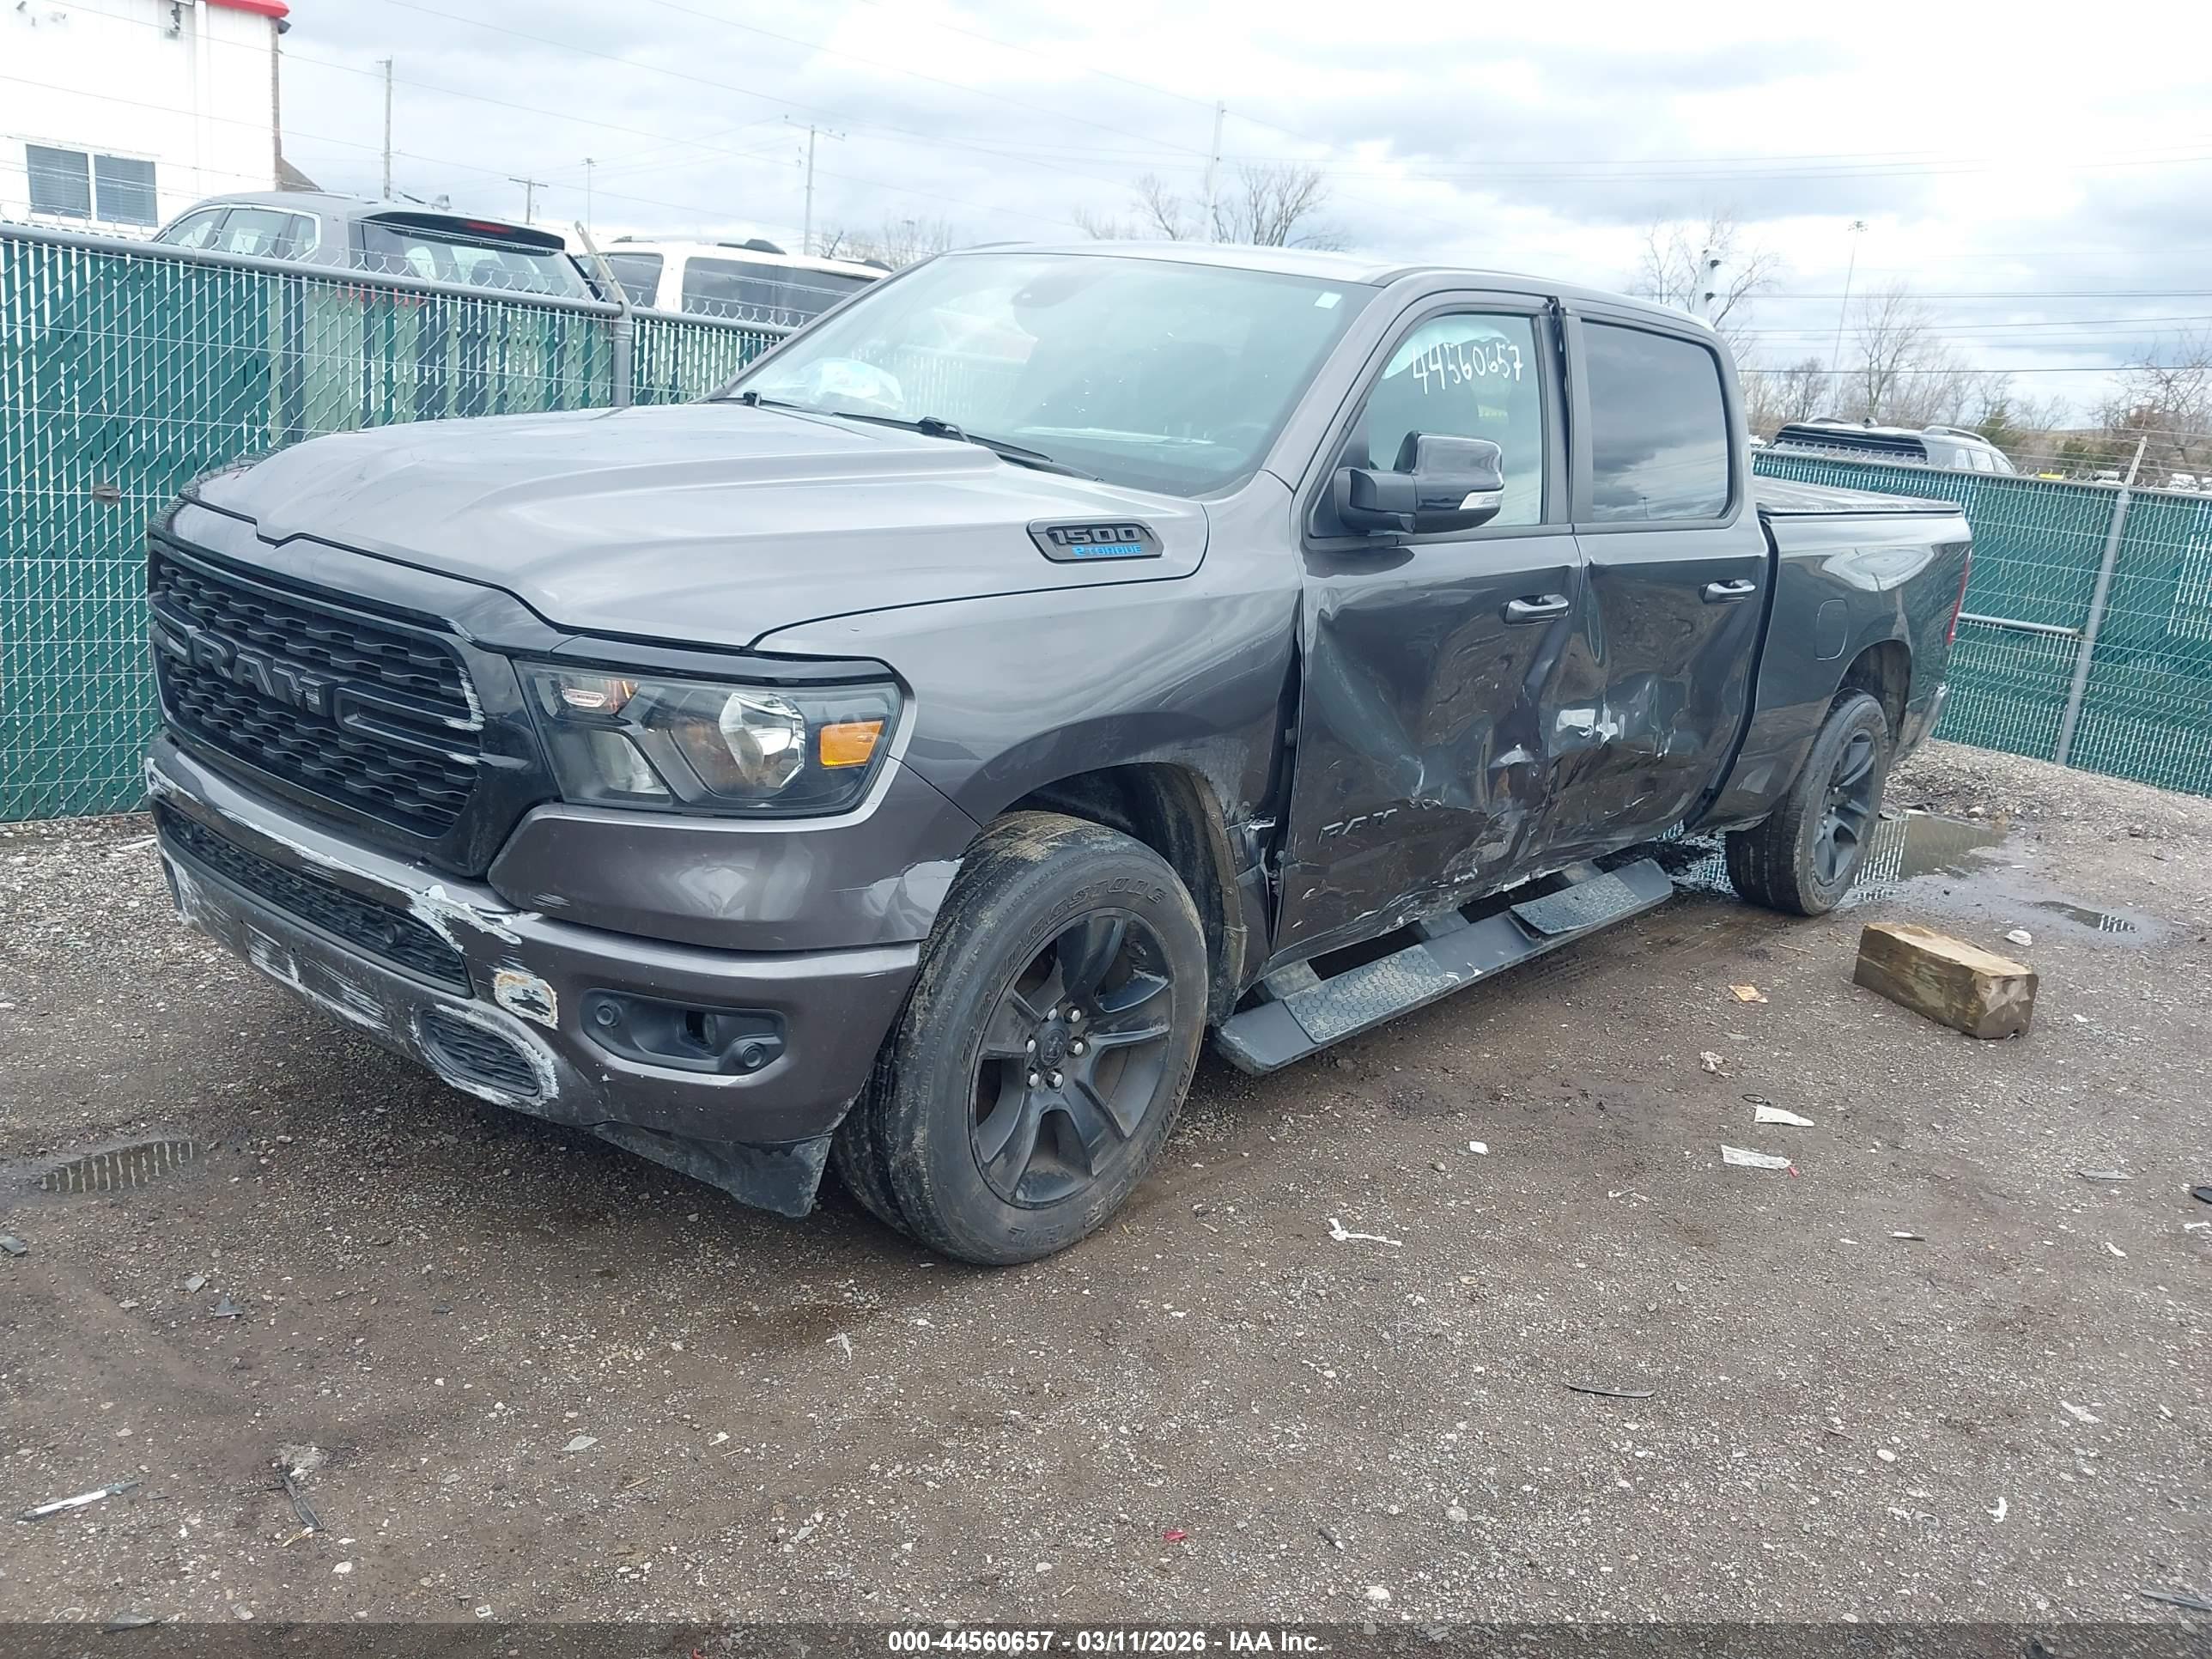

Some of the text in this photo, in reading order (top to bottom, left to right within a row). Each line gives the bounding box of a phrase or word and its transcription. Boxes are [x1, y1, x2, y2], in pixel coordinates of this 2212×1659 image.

[1413, 341, 1523, 394] 44560657
[1048, 527, 1140, 545] 1500
[191, 631, 333, 717] RAM
